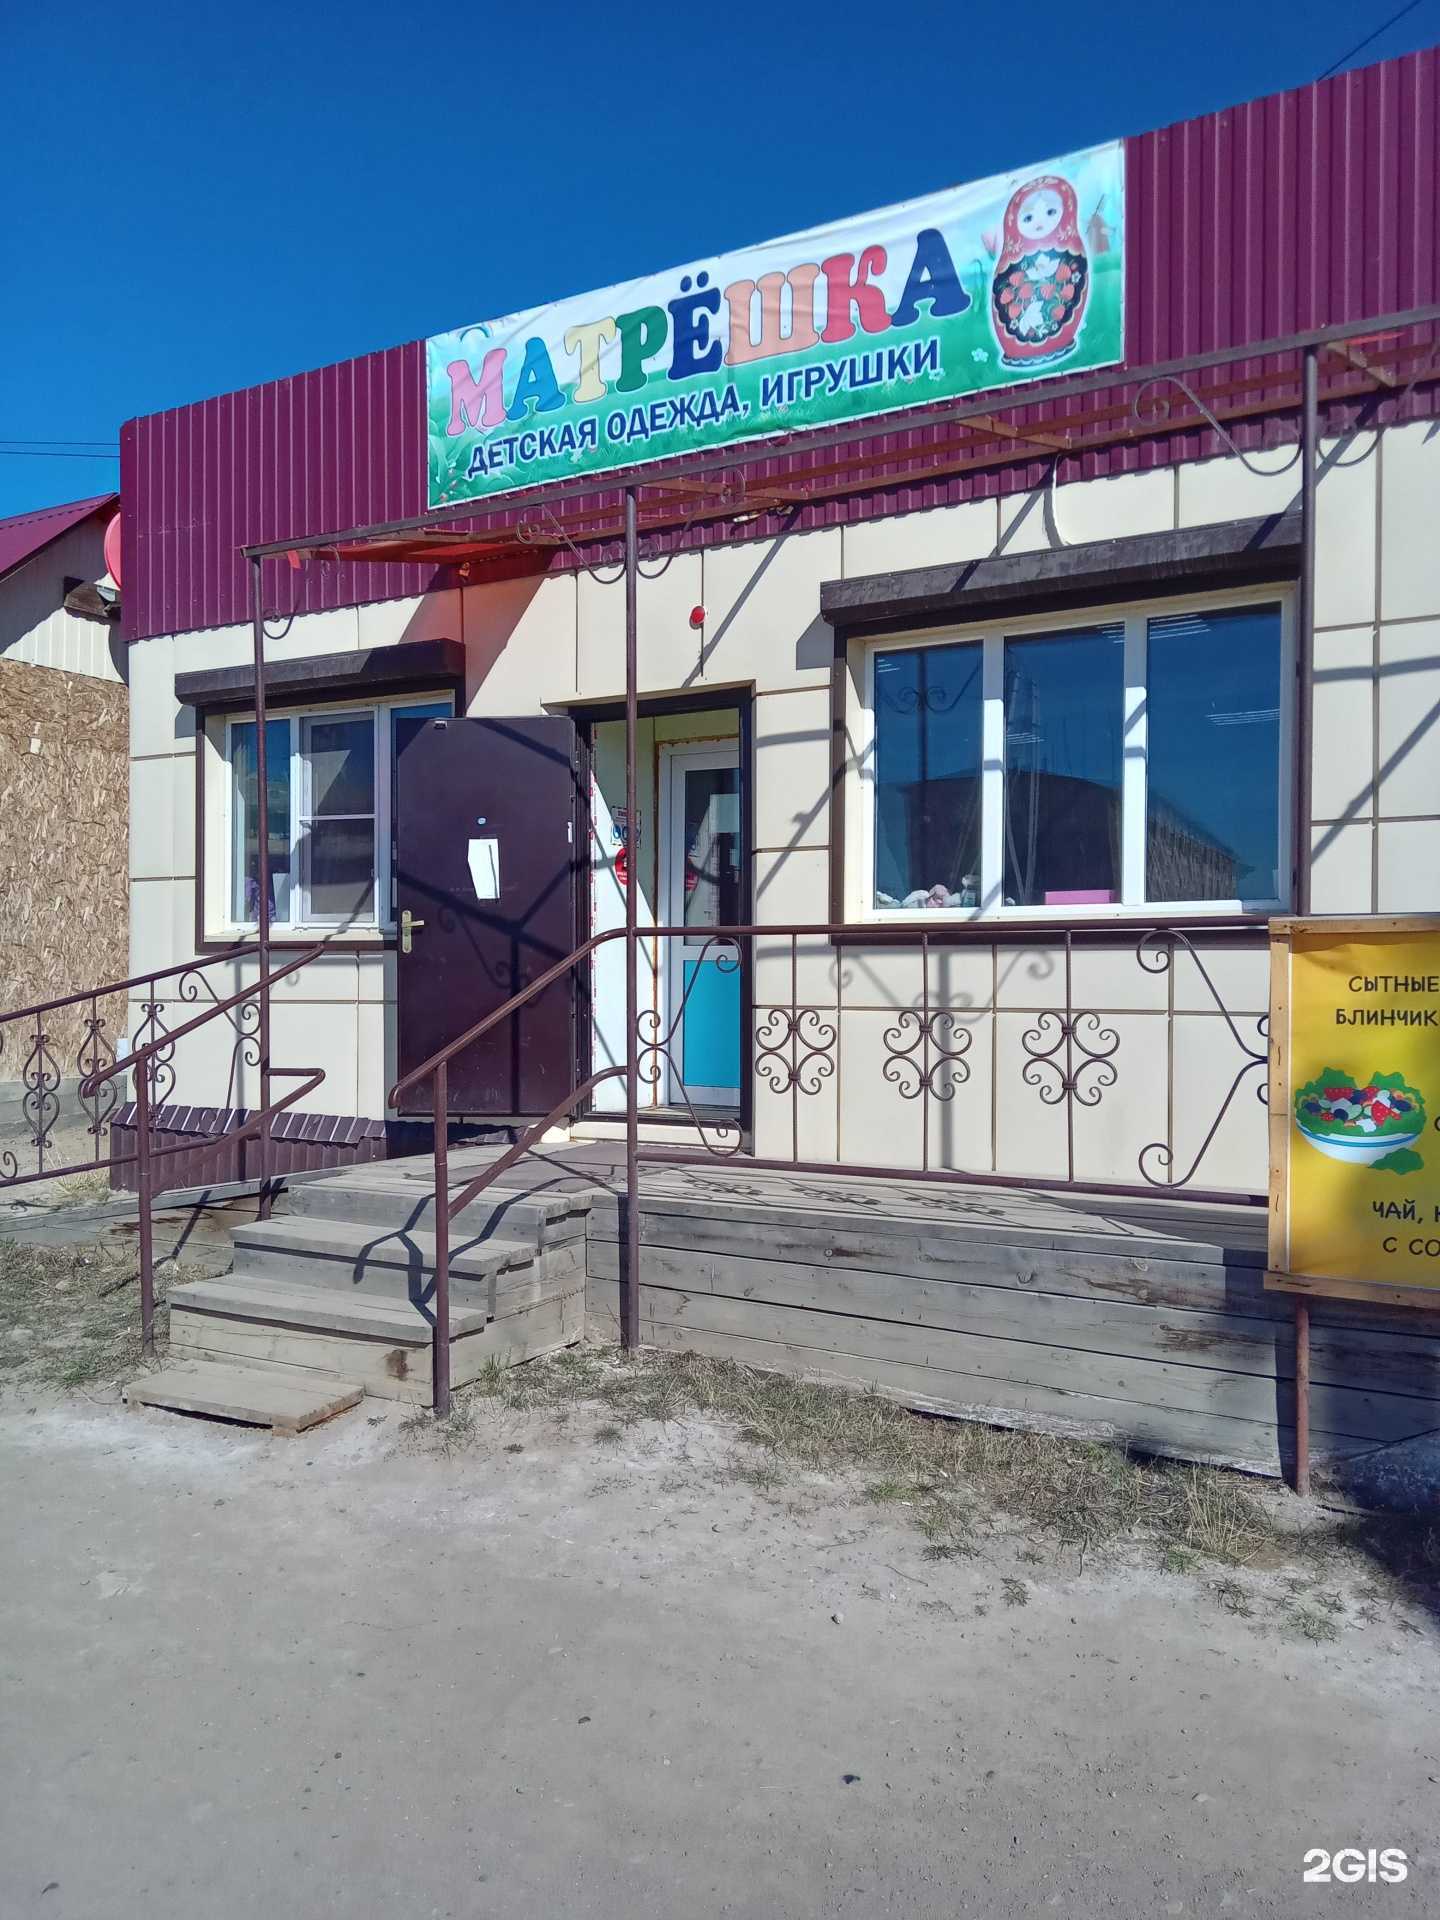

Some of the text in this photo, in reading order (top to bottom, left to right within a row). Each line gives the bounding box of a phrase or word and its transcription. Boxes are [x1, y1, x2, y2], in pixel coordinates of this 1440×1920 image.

[446, 228, 971, 437] МАТРЁШКА
[468, 338, 938, 479] ДЕТСКАЯ ОДЕЖДА, ИГРУШКИ
[1348, 975, 1440, 993] СЫТНЫЕ
[1372, 1198, 1423, 1224] ЧАЙ,
[1383, 1236, 1398, 1253] С
